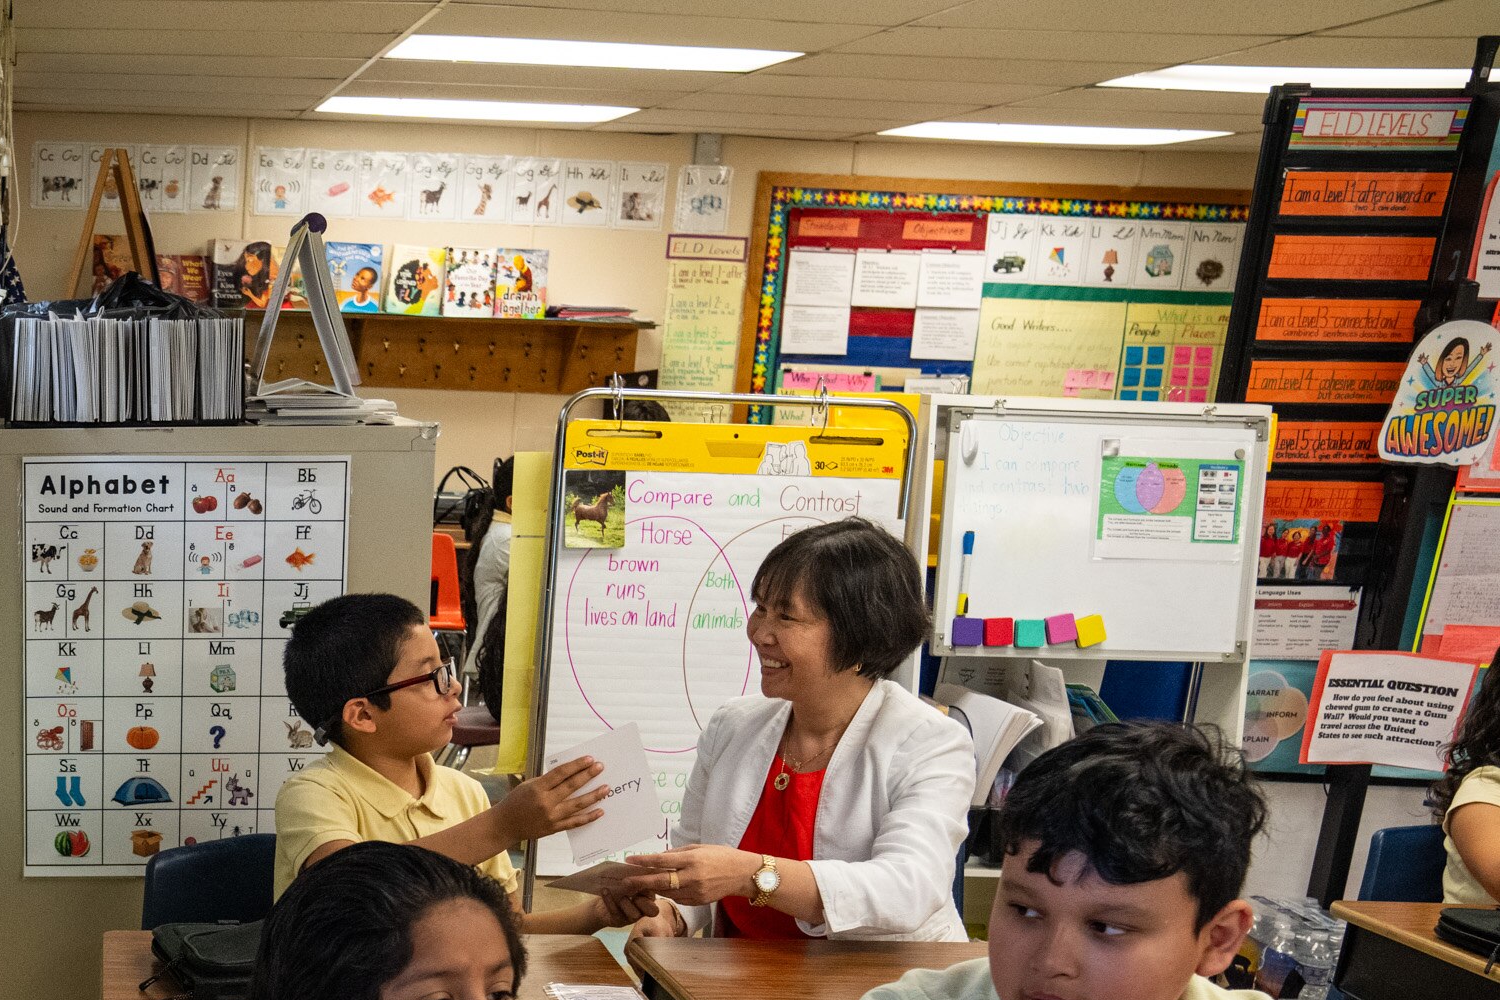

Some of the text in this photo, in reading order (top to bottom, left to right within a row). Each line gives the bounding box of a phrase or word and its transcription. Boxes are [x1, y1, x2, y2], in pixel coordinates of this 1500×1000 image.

[1319, 112, 1432, 136] ELD LEVELS
[1414, 385, 1478, 411] SUPER
[998, 422, 1066, 451] Objective
[1384, 404, 1496, 457] AWESOME!
[576, 450, 605, 458] Post-it
[814, 461, 825, 470] 30
[881, 466, 894, 474] 3M
[215, 468, 235, 483] Aa
[297, 468, 317, 483] Bb
[39, 474, 170, 499] Alphabet
[628, 479, 863, 516] Compare and Contrast
[38, 503, 174, 514] Sound and Formation Chart
[59, 525, 79, 539] Cc
[135, 525, 154, 540] Dd
[215, 526, 234, 540] Ee
[296, 525, 312, 540] Ff
[641, 521, 693, 545] Horse
[608, 553, 659, 572] brown
[705, 571, 735, 590] Both
[56, 583, 76, 601] Gg
[134, 583, 153, 597] Hh
[217, 583, 230, 597] Ii
[294, 583, 309, 600] Jj
[606, 583, 646, 601] runs
[584, 597, 677, 628] lives on land
[692, 607, 743, 630] animals
[58, 642, 77, 656] Kk
[138, 642, 150, 655] Ll
[209, 641, 235, 655] Mm
[1328, 678, 1459, 698] ESSENTIAL QUESTION
[57, 703, 77, 717] Oo
[1332, 693, 1350, 701] How
[1361, 695, 1376, 703] you
[1377, 694, 1394, 703] feel
[1395, 697, 1424, 707] about
[1426, 702, 1455, 712] using
[135, 703, 153, 720] Pp
[210, 703, 233, 720] Qq
[1325, 703, 1353, 711] chewed
[1382, 705, 1413, 716] create
[1423, 710, 1448, 720] Gum
[1348, 713, 1372, 721] Would
[1371, 714, 1389, 723] you
[1391, 715, 1416, 726] want
[1418, 719, 1429, 727] to
[1320, 722, 1342, 730] travel
[1367, 723, 1381, 731] the
[1383, 724, 1417, 735] United
[1317, 731, 1341, 739] States
[1363, 732, 1384, 741] such
[1385, 734, 1442, 747] attraction?
[59, 759, 77, 772] Ss
[137, 759, 150, 772] Tt
[211, 758, 230, 772] Uu
[288, 758, 305, 772] Vv
[55, 813, 81, 827] Ww
[135, 812, 152, 826] Xx
[211, 813, 227, 830] Yy
